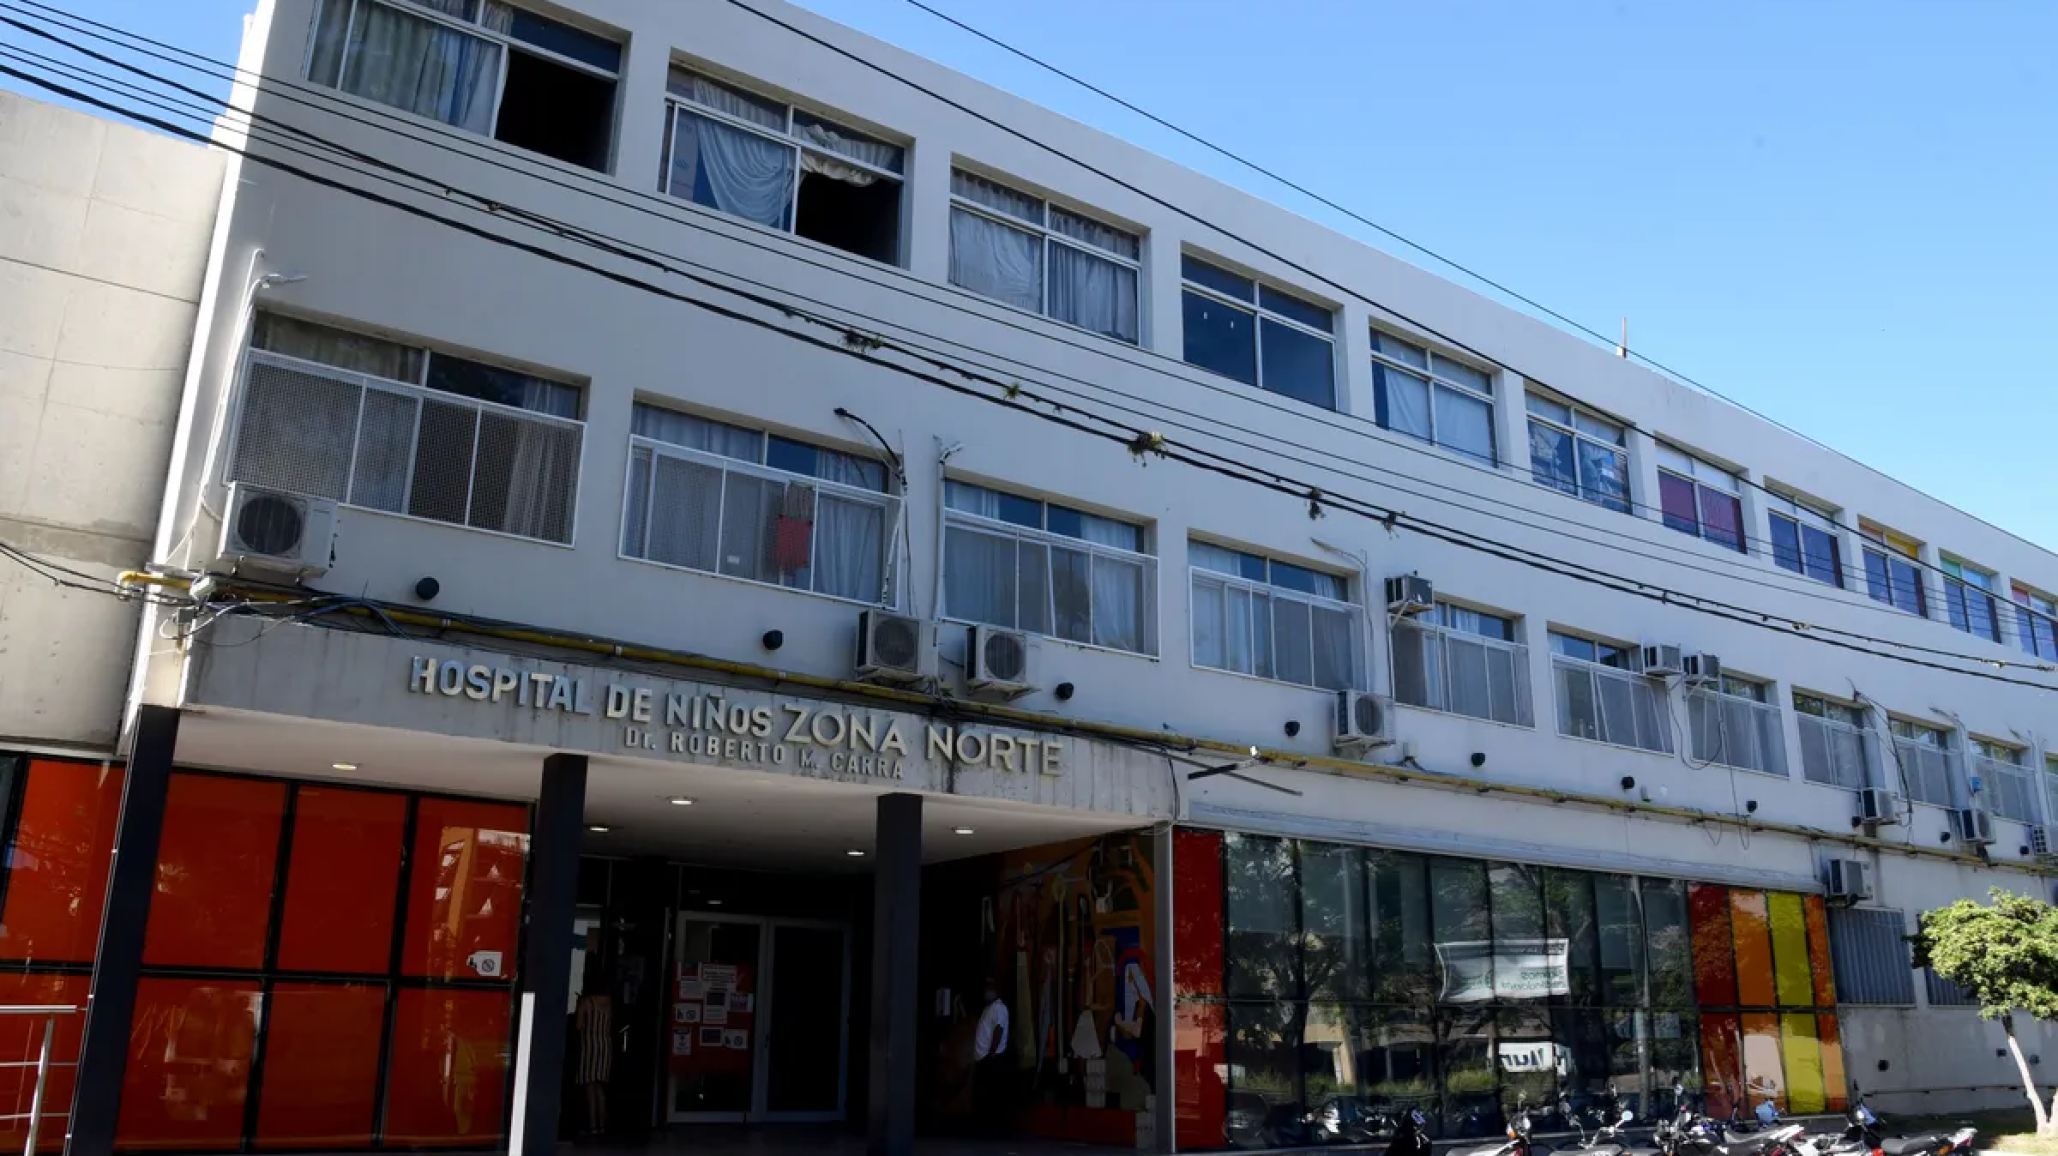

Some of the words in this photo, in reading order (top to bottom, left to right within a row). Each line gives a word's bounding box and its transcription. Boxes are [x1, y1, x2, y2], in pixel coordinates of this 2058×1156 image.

[409, 655, 591, 715] HOSPITAL
[606, 682, 652, 723] DE
[665, 691, 773, 738] NIÑOS
[781, 703, 908, 757] ZONA
[925, 724, 1064, 777] NORTE
[670, 731, 786, 764] ROBERTO
[831, 752, 903, 778] CARRA
